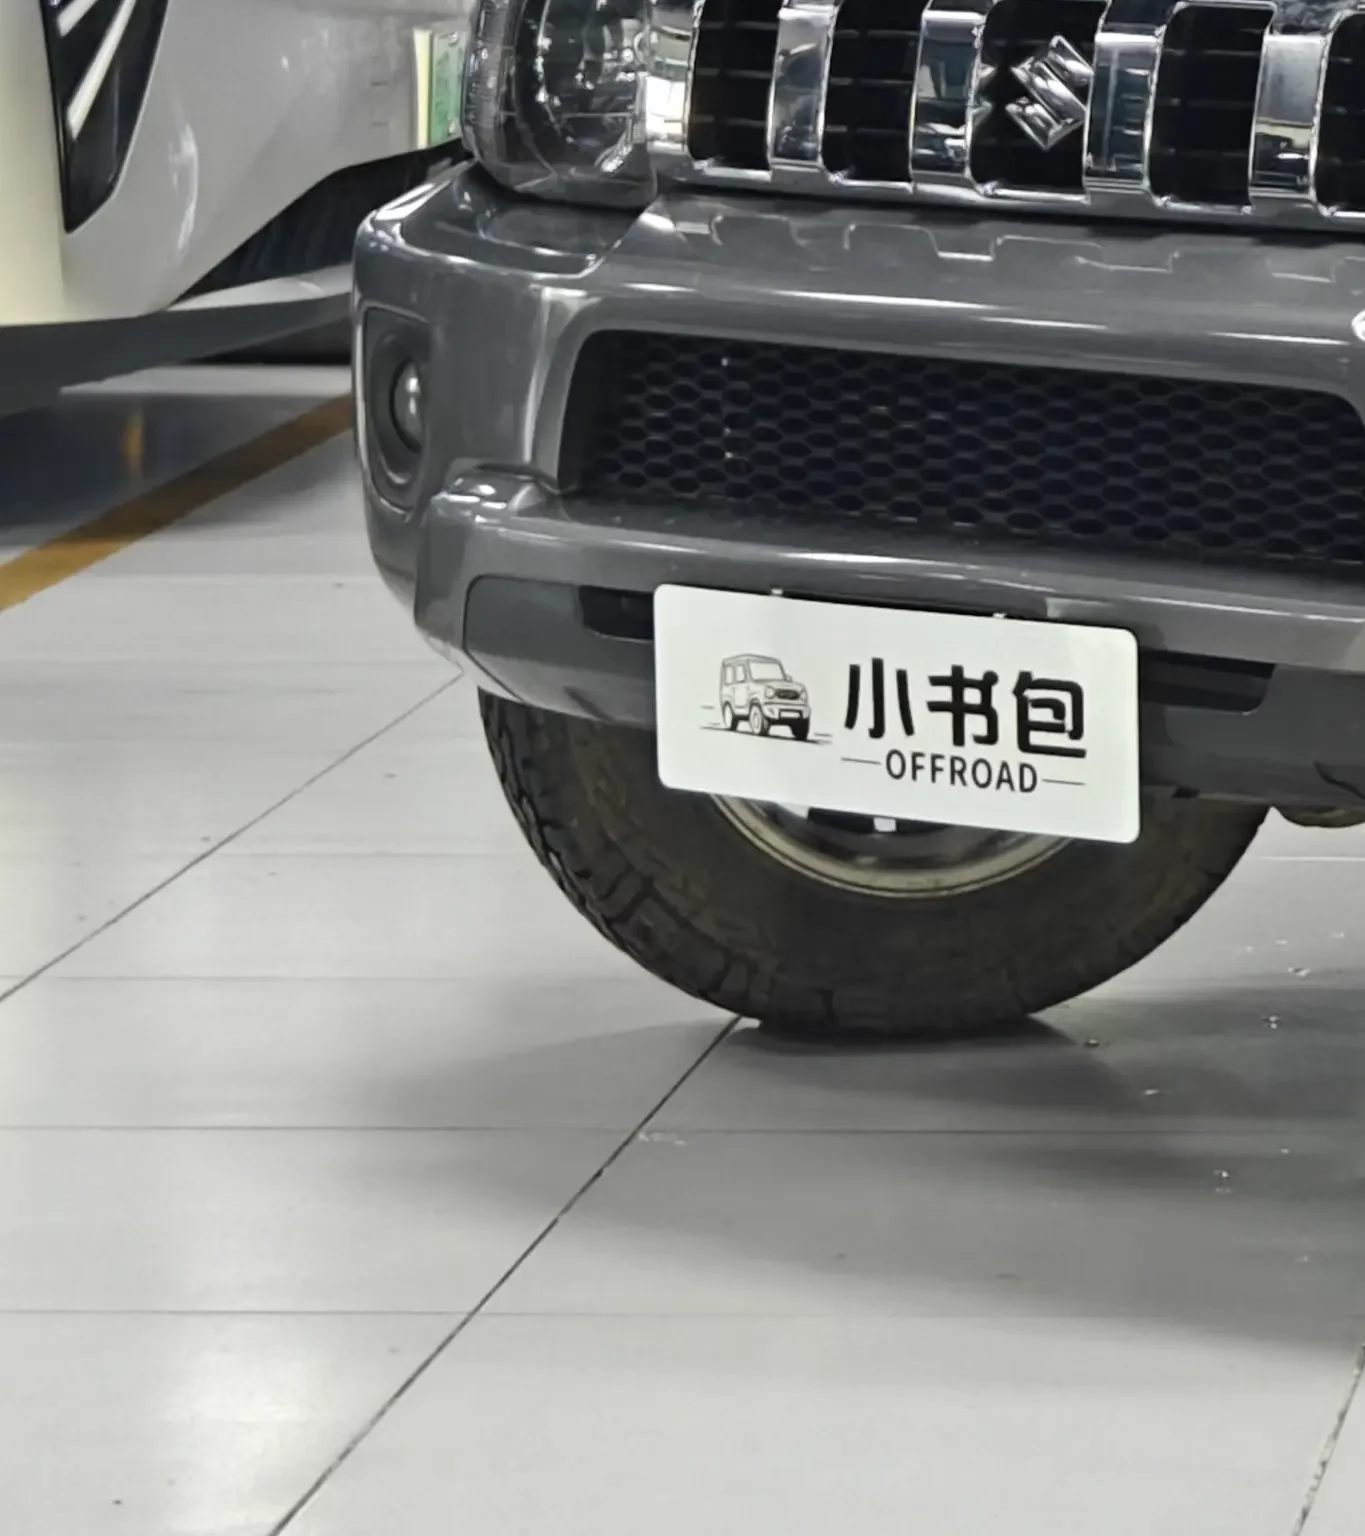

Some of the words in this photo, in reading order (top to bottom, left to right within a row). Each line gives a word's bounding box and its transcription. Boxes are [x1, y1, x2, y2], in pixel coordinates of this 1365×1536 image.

[844, 657, 1087, 759] 小书包
[885, 748, 1038, 794] OFFROAD
